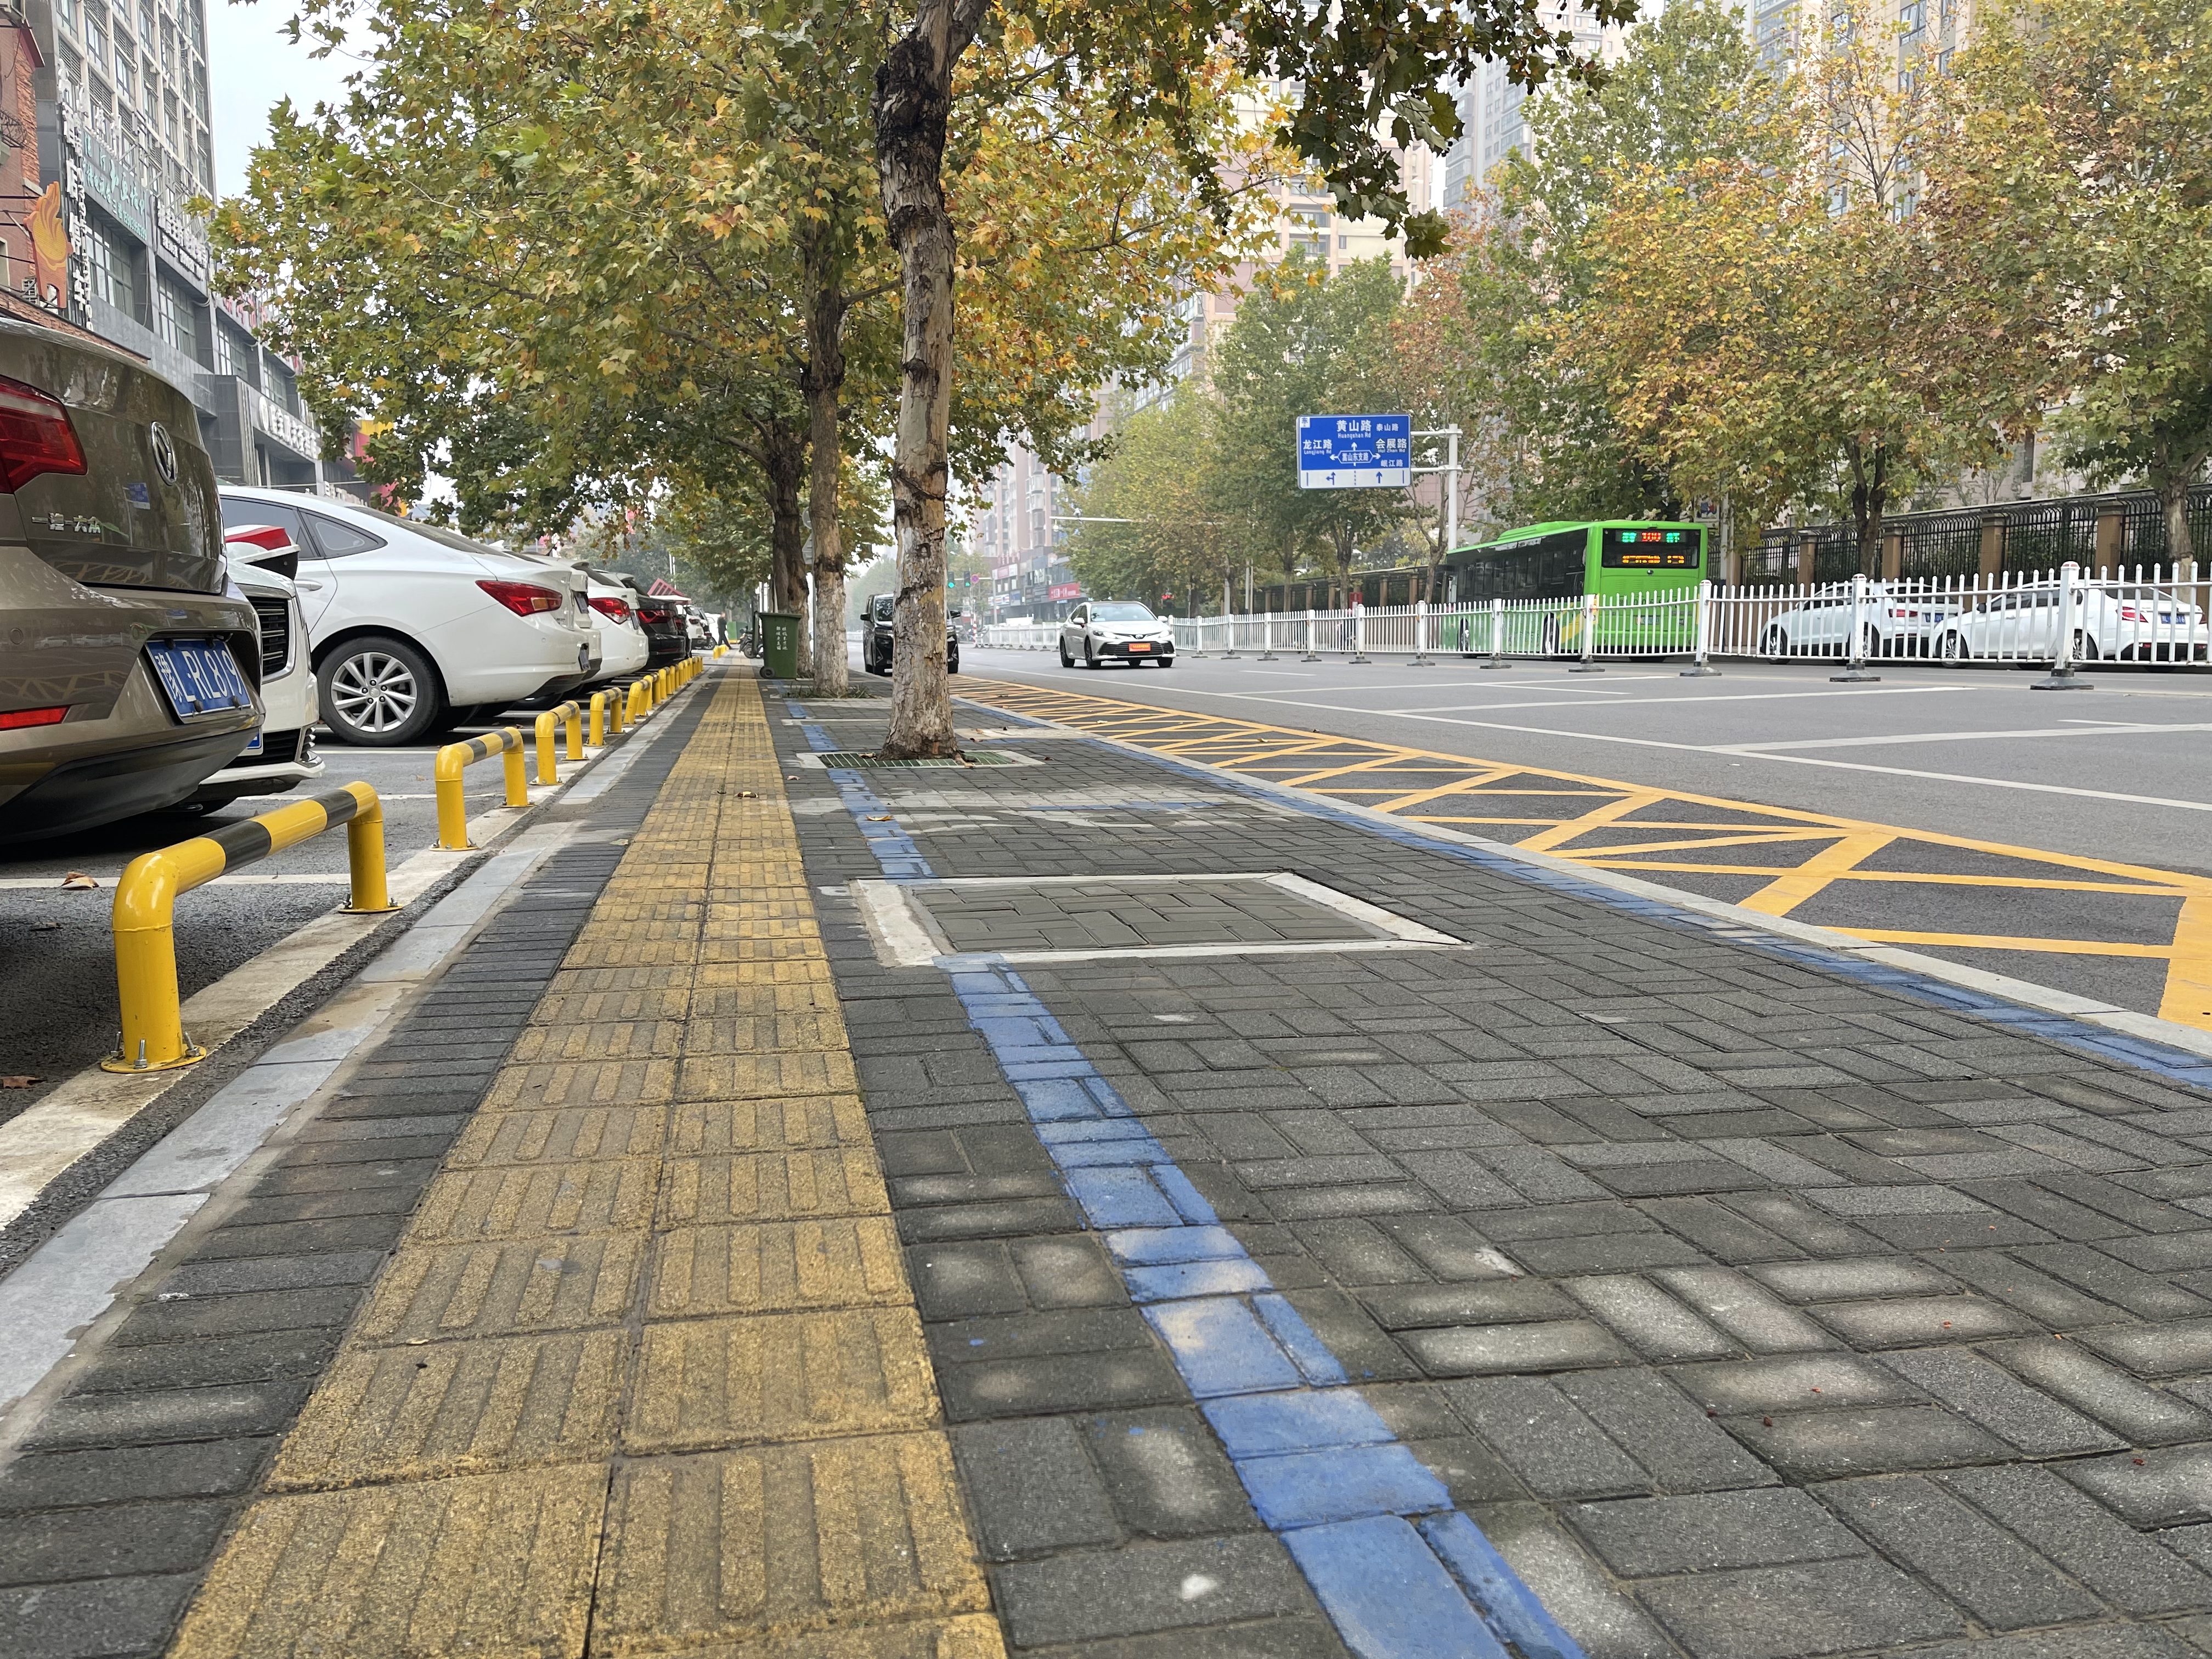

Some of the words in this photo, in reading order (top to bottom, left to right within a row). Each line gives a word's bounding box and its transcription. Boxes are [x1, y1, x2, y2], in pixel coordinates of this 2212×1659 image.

[1336, 420, 1372, 432] 黄山路
[1302, 439, 1333, 450] 龙江路
[1375, 438, 1407, 449] 会展路
